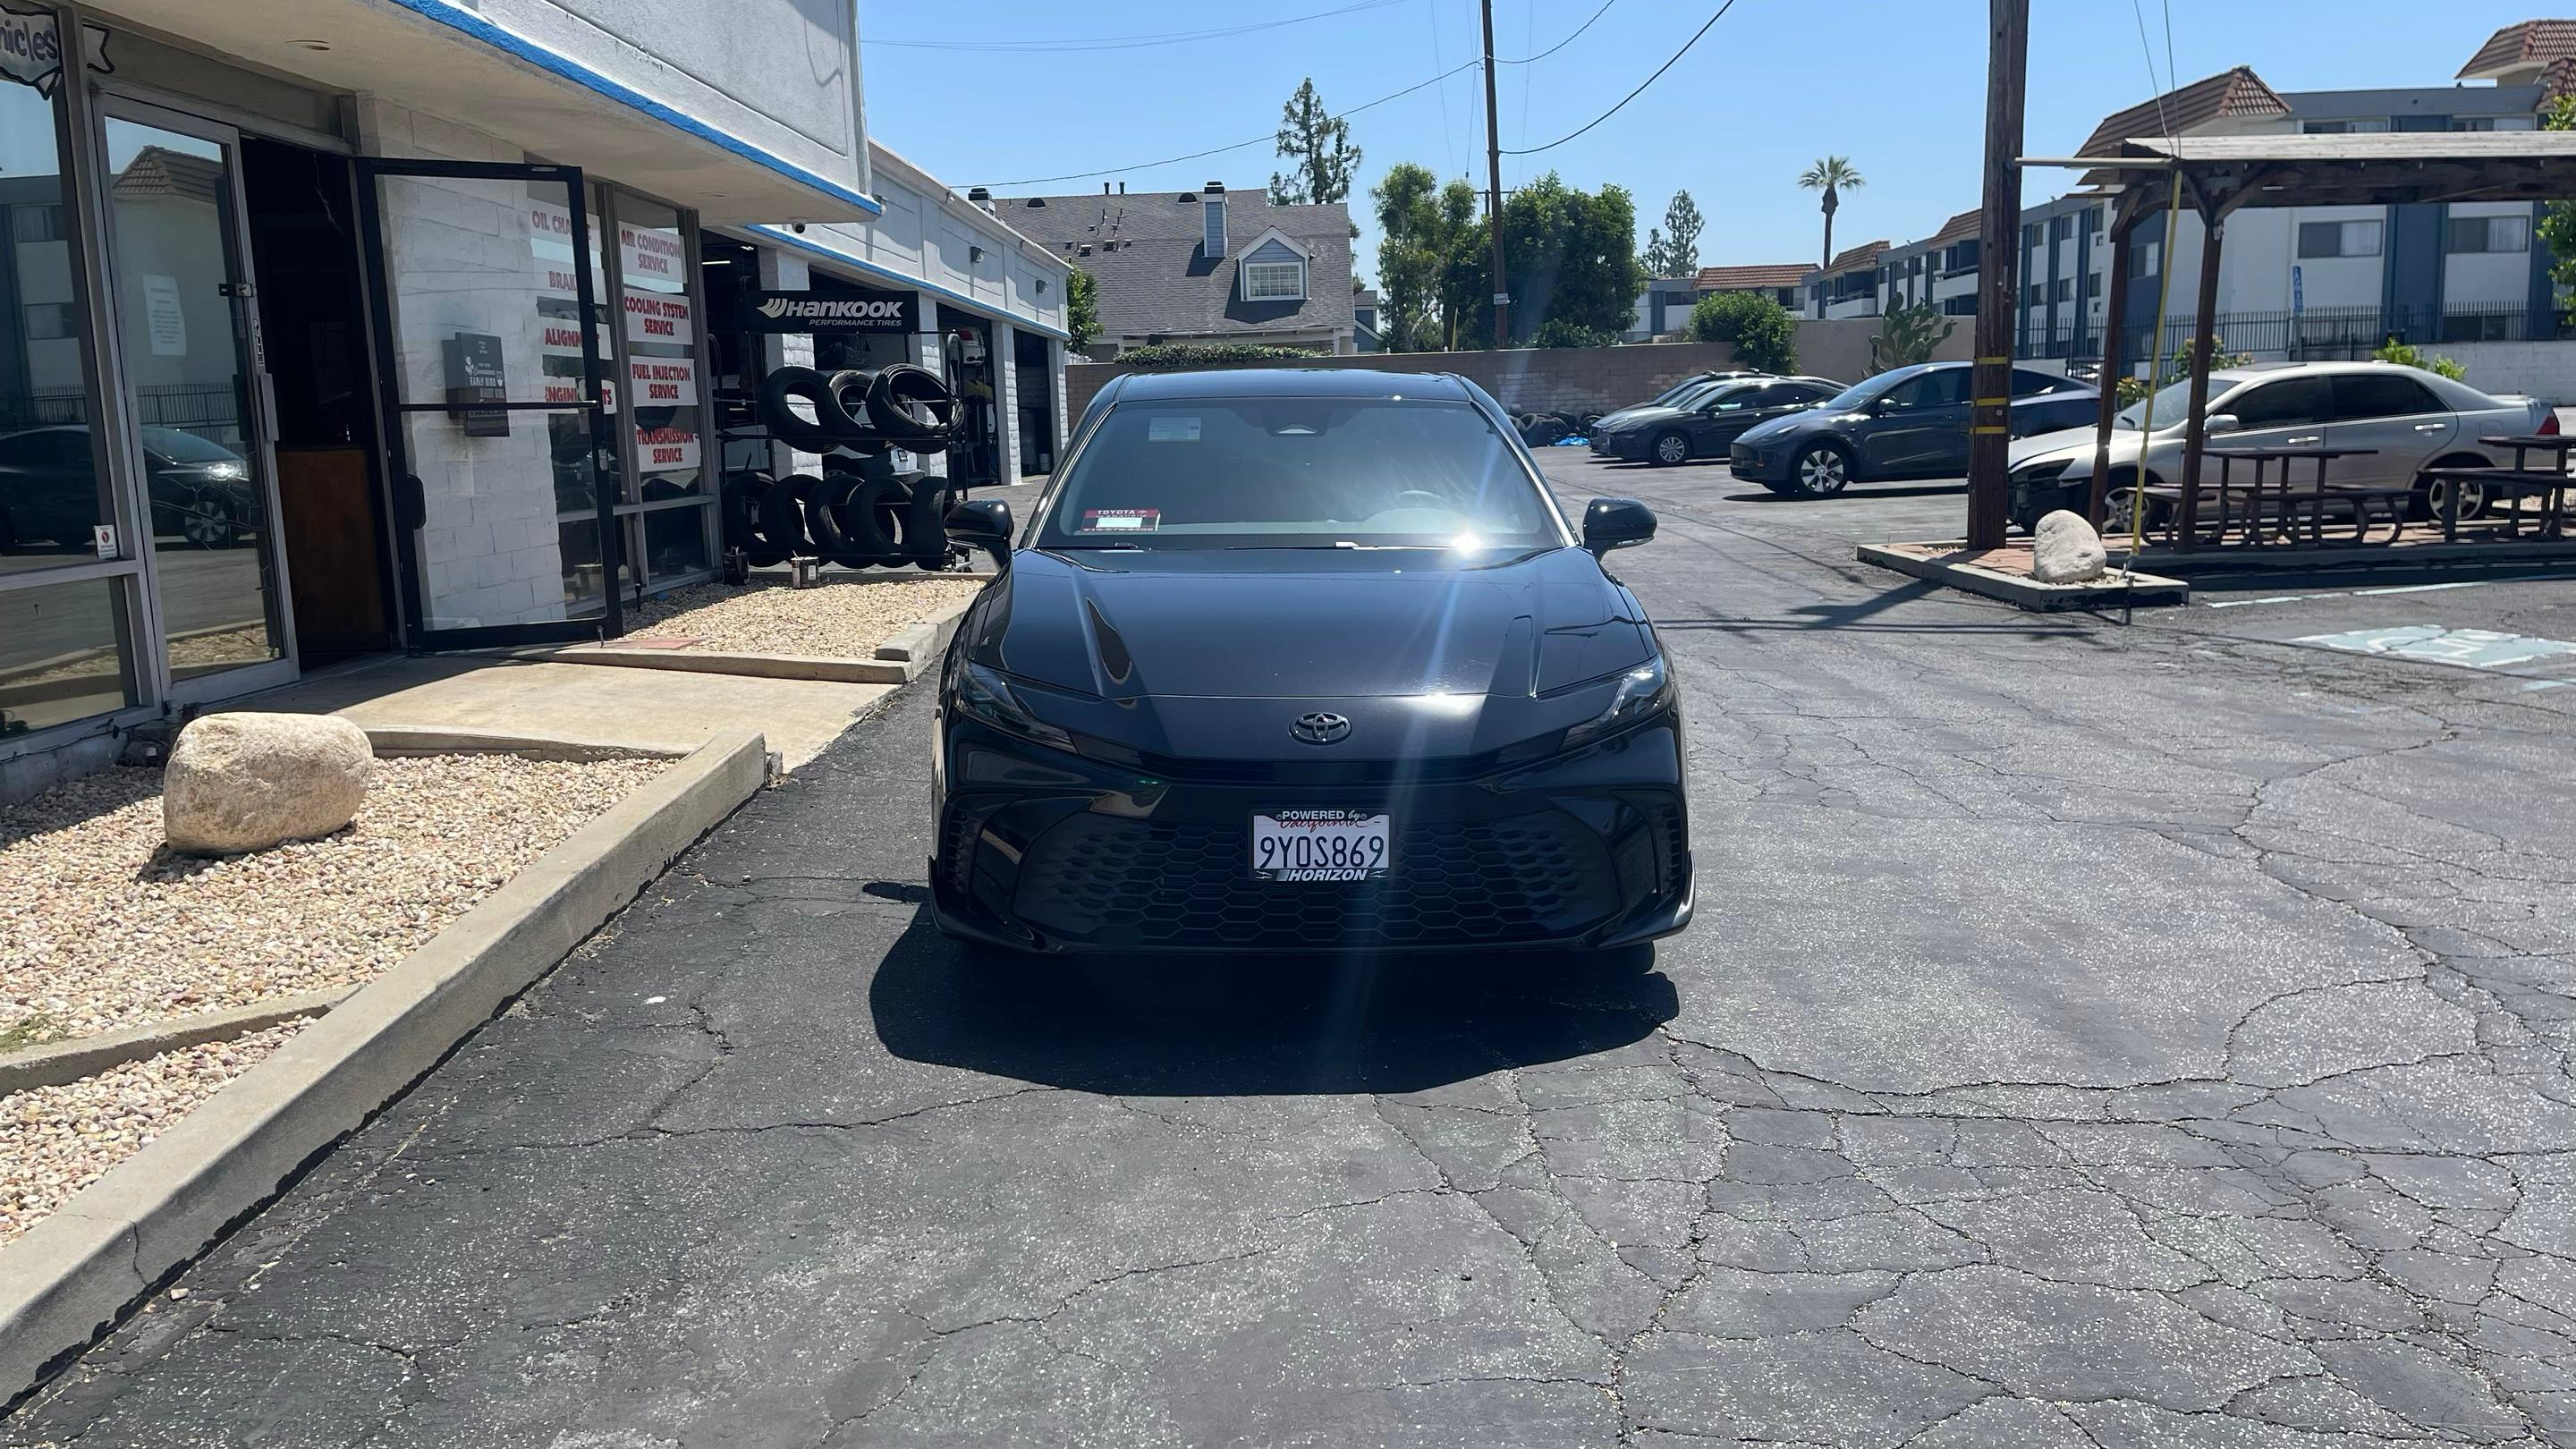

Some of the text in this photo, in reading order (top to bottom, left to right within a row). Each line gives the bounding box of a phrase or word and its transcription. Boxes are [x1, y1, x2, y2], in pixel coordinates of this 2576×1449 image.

[531, 210, 550, 232] OIL
[622, 229, 681, 258] AIR CONDITION
[639, 252, 668, 274] SERVICE
[624, 296, 661, 317] COOLING
[644, 318, 674, 336] SERVICE
[809, 318, 902, 327] PERFORMANCE TIRES
[631, 363, 691, 382] FUEL INJECTION
[648, 383, 679, 400] SERVICE
[637, 428, 695, 445] TRANSMISSION
[652, 448, 682, 464] SERVICE
[1282, 809, 1361, 823] POWERED by
[1288, 869, 1368, 882] HORIZON
